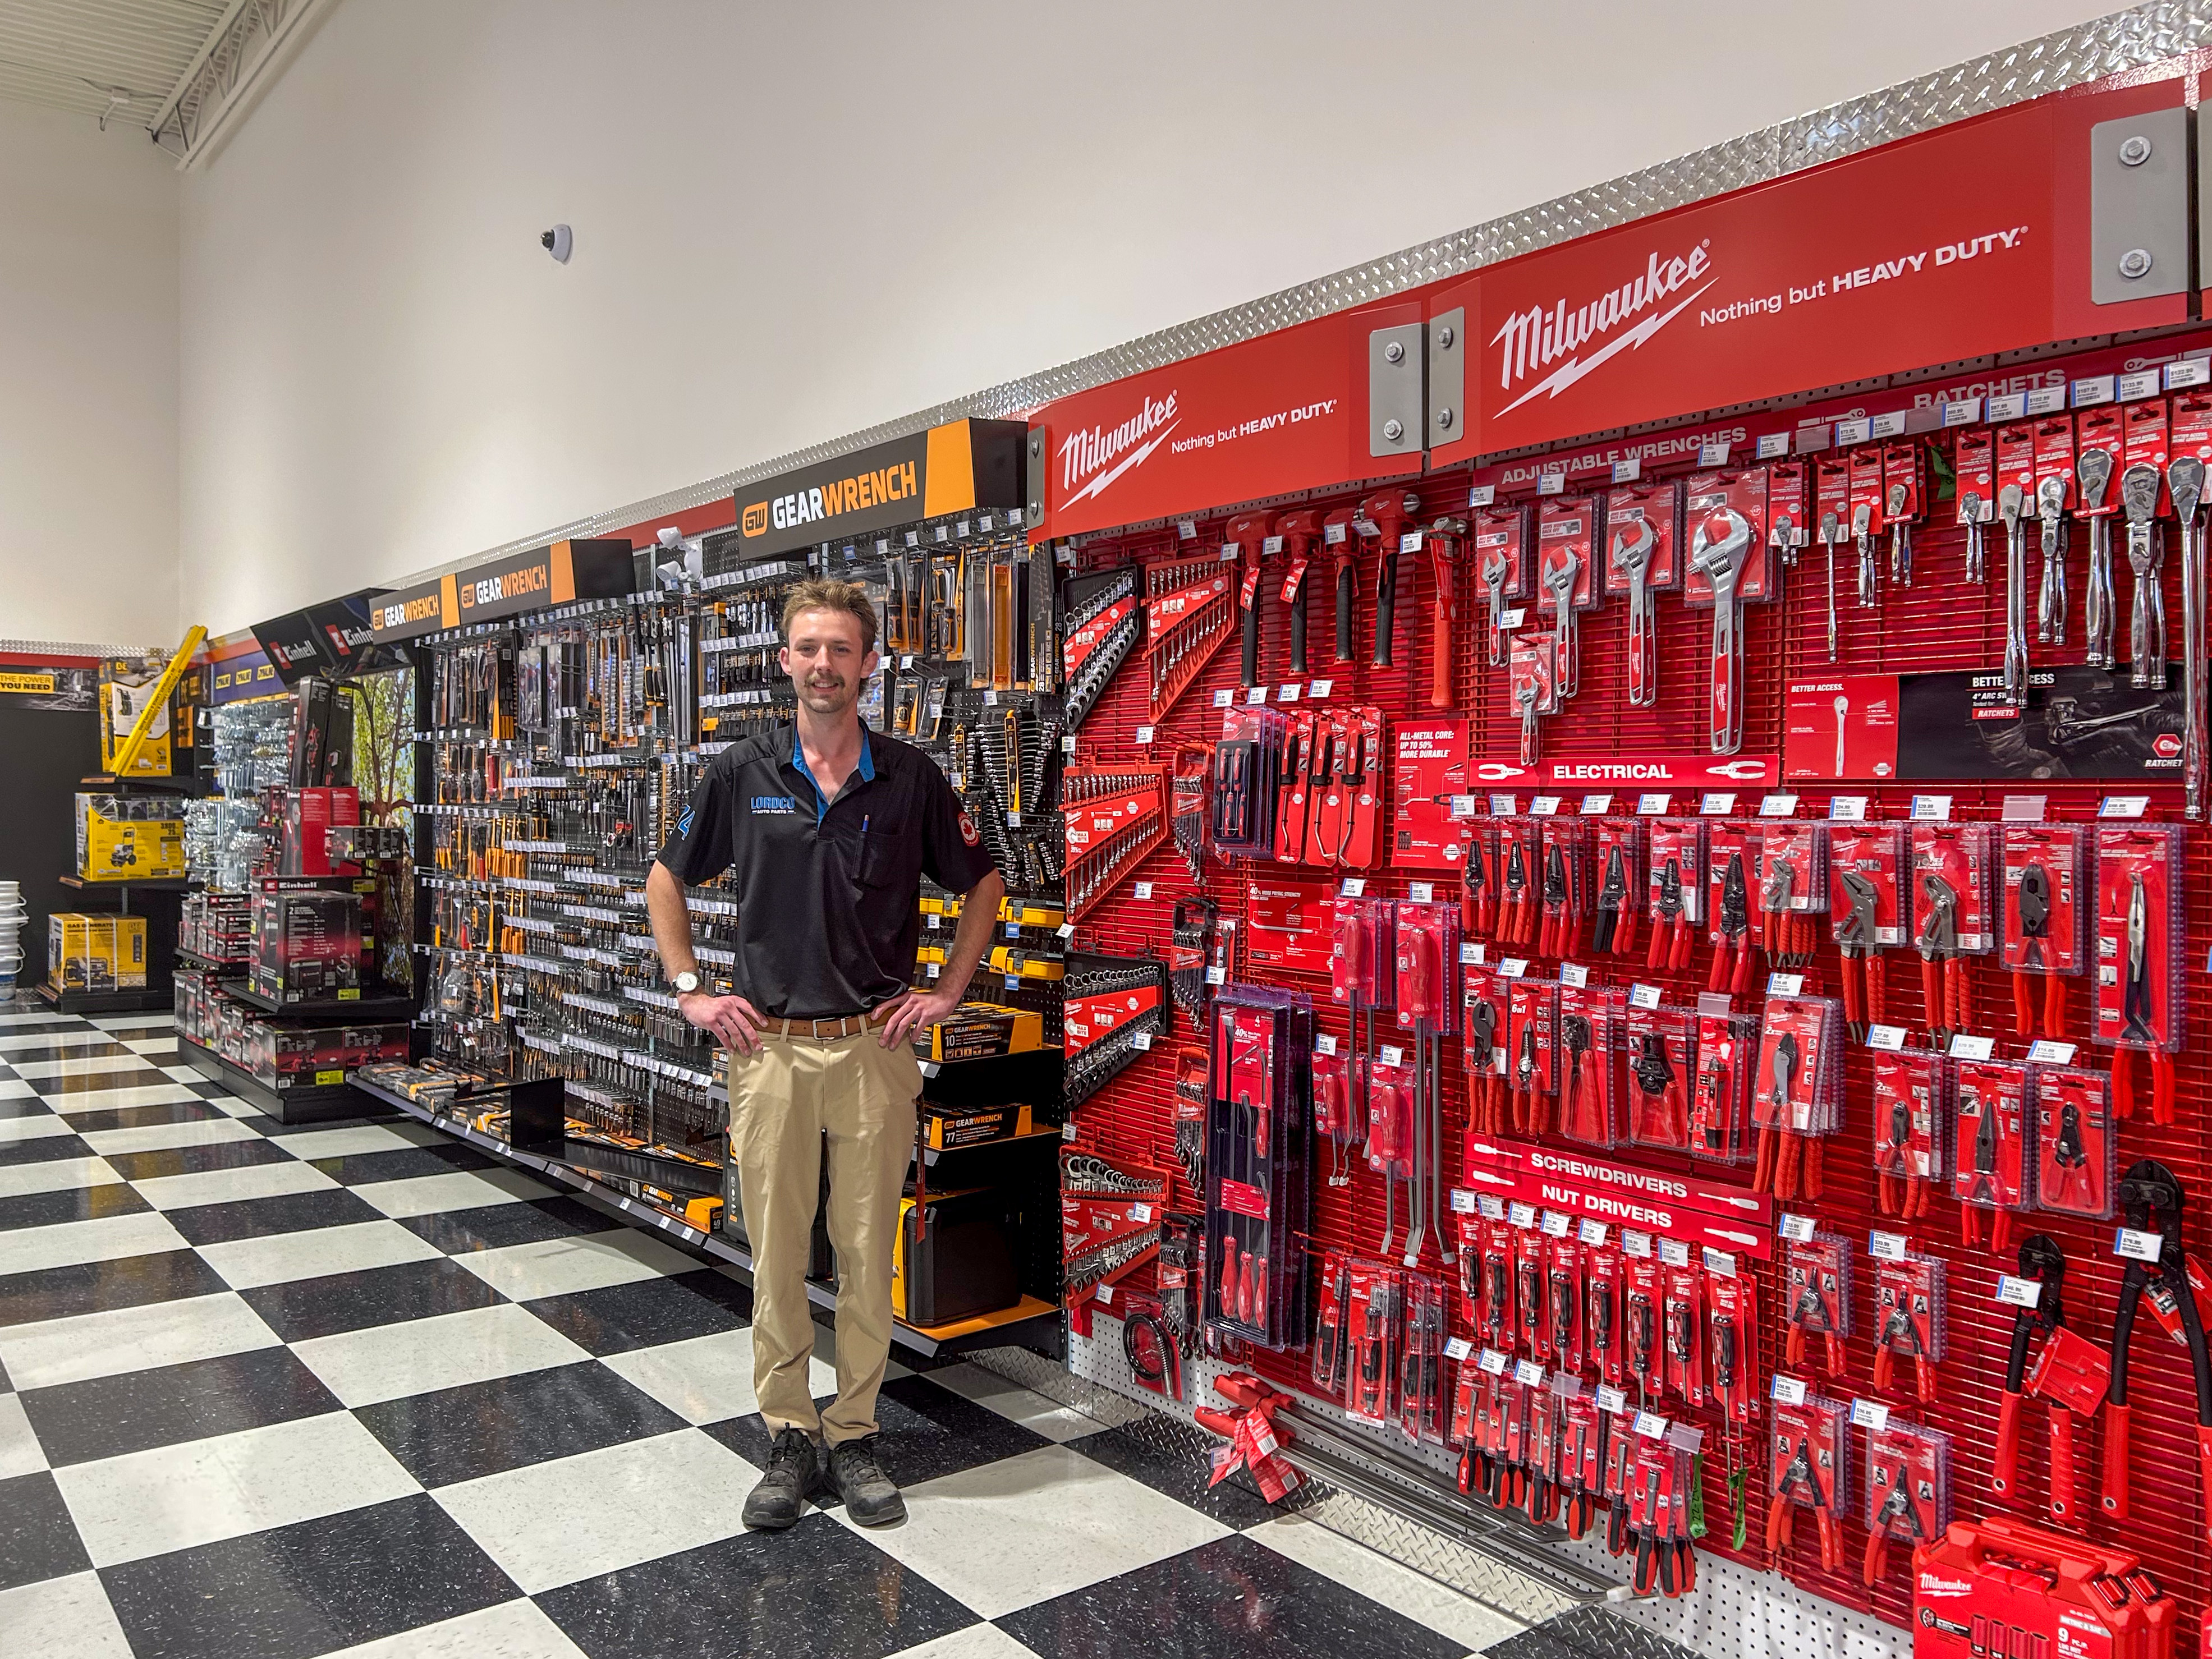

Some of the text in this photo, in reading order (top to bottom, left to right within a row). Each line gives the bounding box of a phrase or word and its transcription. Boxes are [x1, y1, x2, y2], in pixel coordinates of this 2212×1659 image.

[1700, 294, 1782, 328] Nothing
[1790, 279, 1827, 306] but
[1833, 252, 1928, 293] HEAVY
[1915, 369, 2066, 409] RATCHETS
[1171, 431, 1215, 455] Nothing
[1217, 425, 1237, 442] but
[1240, 412, 1287, 436] HEAVY
[1502, 426, 1747, 484] ADJUSTABLE WRENCHES
[772, 460, 917, 530] GEARWRENCH
[476, 564, 548, 605] GEARWRENCH
[384, 594, 440, 627] GEARWRENCH
[341, 627, 373, 646] Einhe
[281, 639, 318, 662] Einhell
[1, 674, 51, 684] THE POWER
[1972, 676, 2004, 688] BETTE
[1791, 683, 1844, 693] BETTER ACCESS.
[1977, 709, 2015, 718] RATCHETS
[1399, 730, 1454, 740] ALL-METAL CORE:
[1419, 741, 1433, 750] 50%
[1553, 764, 1673, 779] ELECTRICAL
[751, 796, 795, 810] LORDCO
[954, 1023, 990, 1033] GEARWRENCH
[1235, 1028, 1248, 1038] 40%
[945, 1035, 955, 1047] 10
[956, 1113, 1003, 1127] GEARWRENCH
[946, 1132, 956, 1143] 77
[1531, 1152, 1687, 1198] SCREWDRIVERS
[1542, 1184, 1672, 1229] NUT DRIVERS
[1919, 1572, 1973, 1591] Milwaukee
[2058, 1627, 2069, 1643] 9
